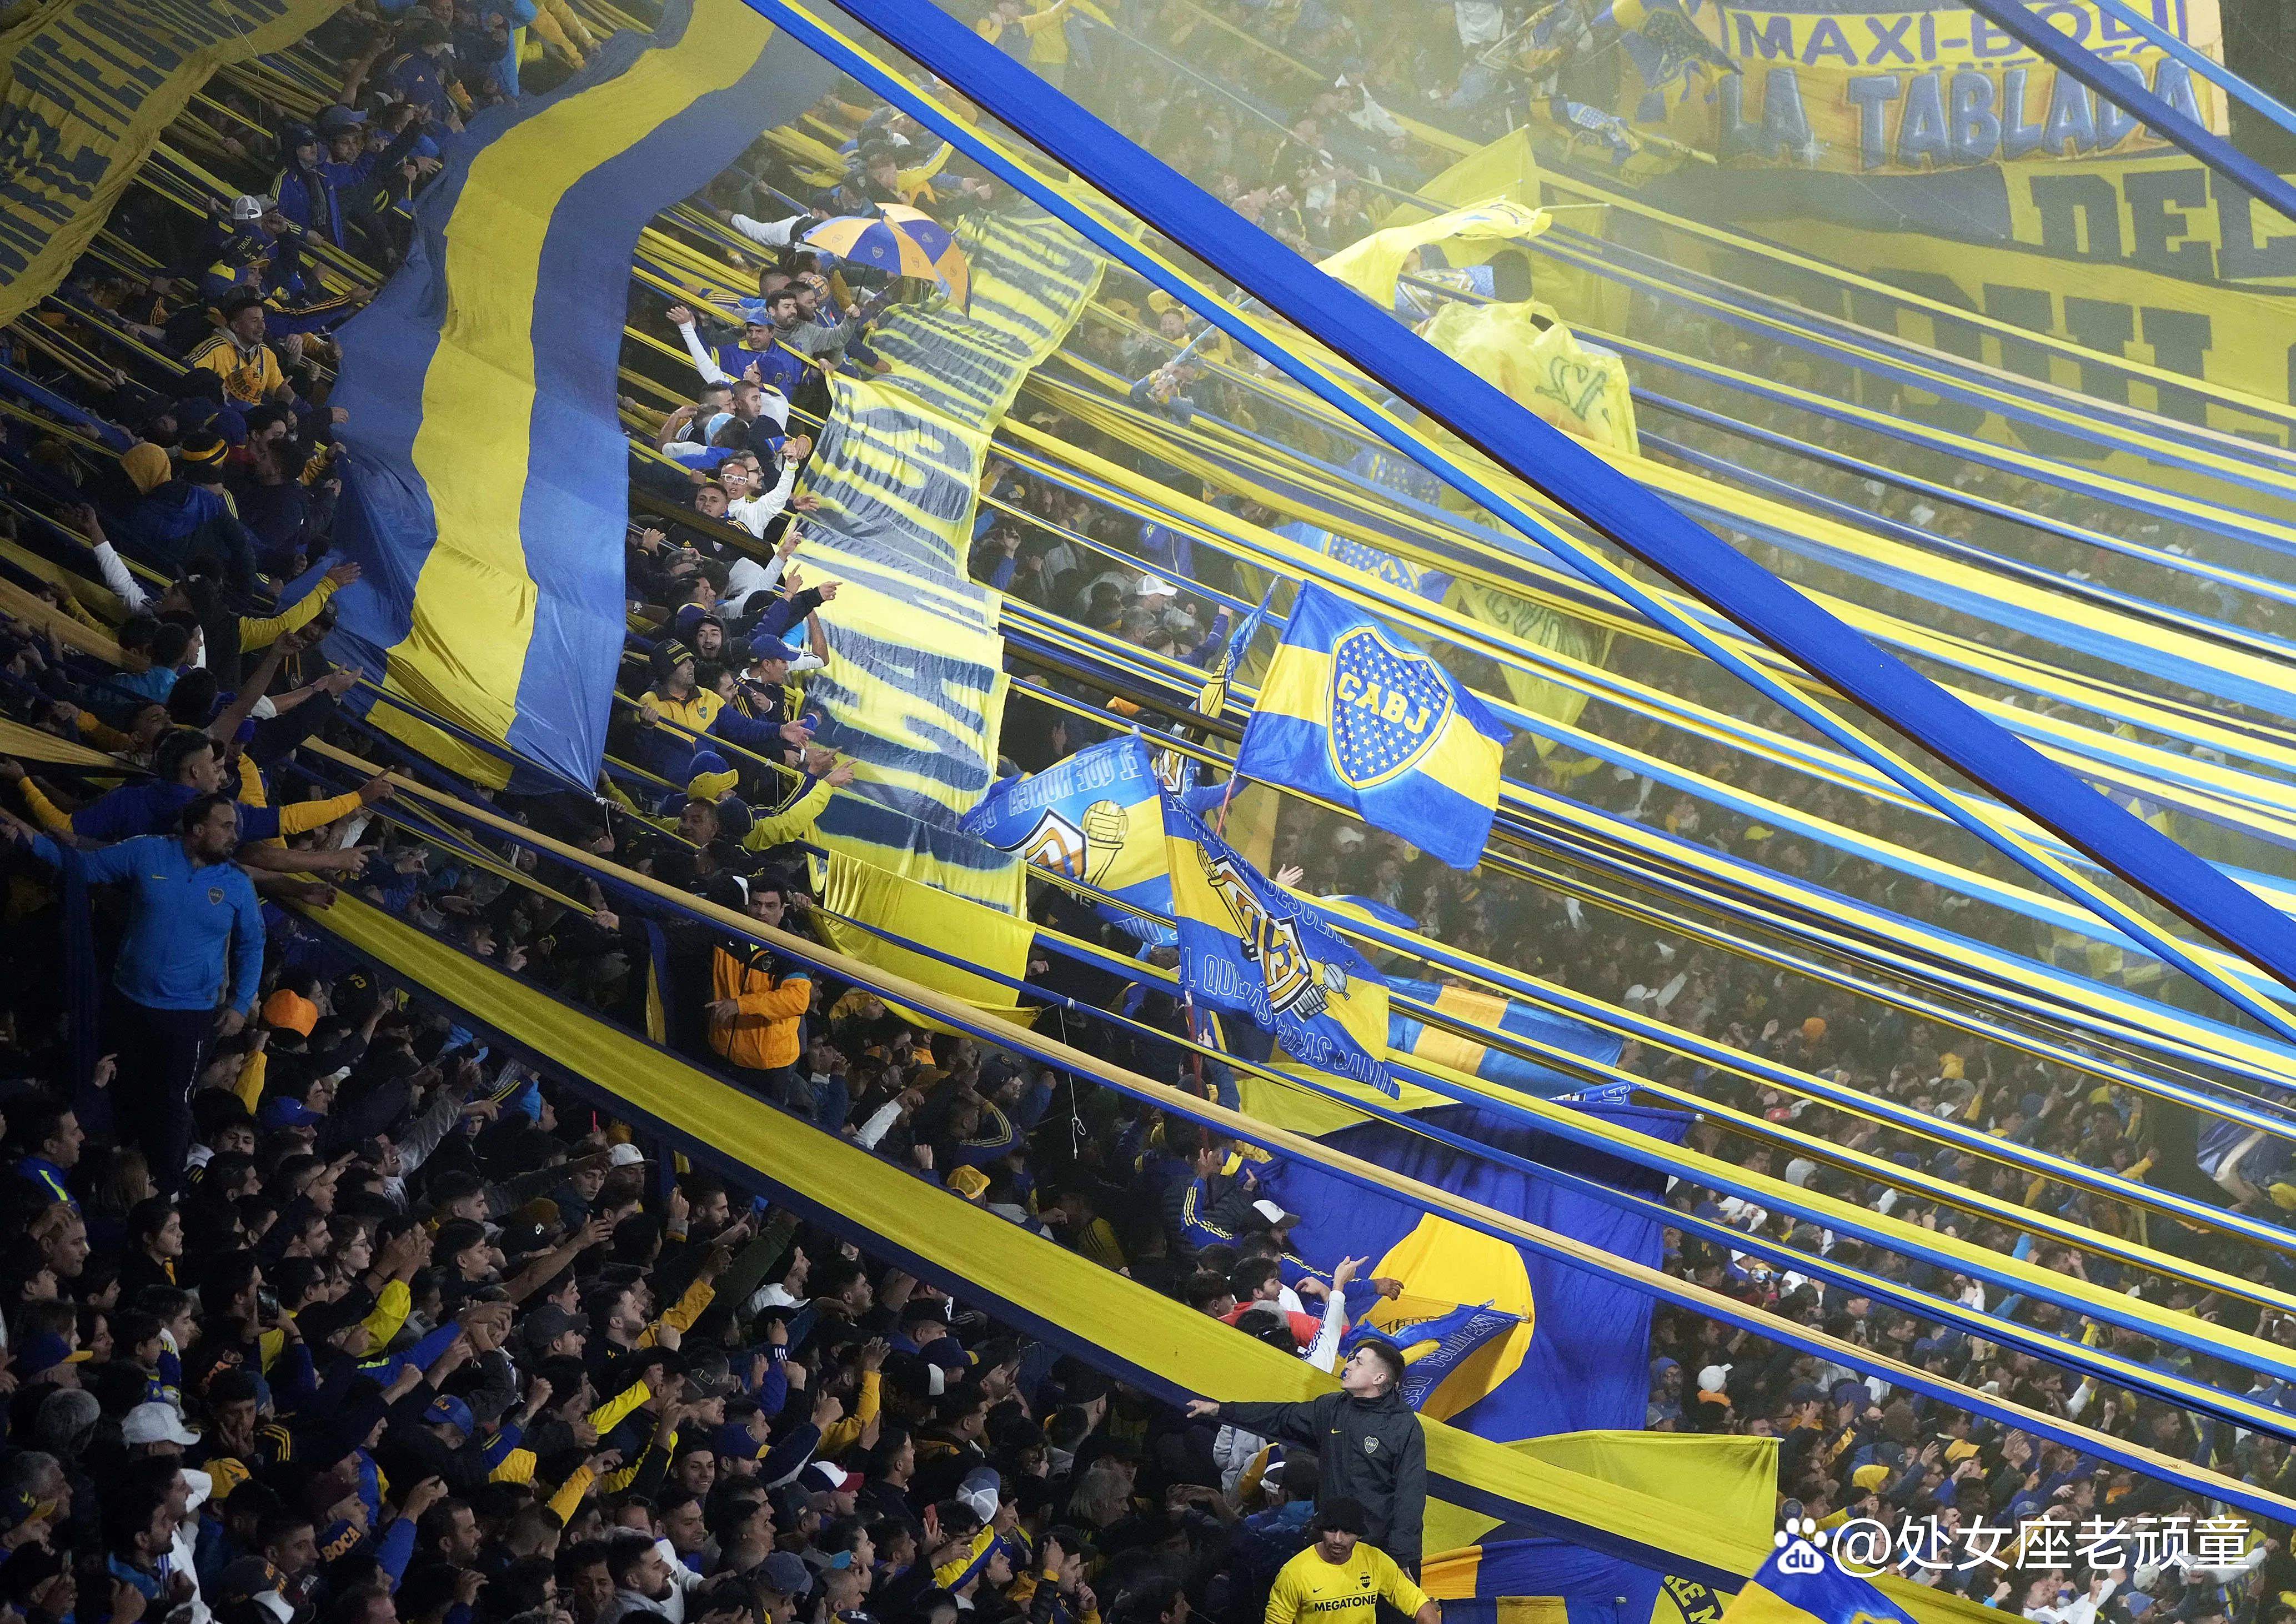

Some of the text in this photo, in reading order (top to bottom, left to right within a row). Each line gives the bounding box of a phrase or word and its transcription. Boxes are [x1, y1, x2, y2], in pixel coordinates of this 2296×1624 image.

[1847, 59, 2205, 169] TABLADA
[1337, 672, 1431, 734] CABJ
[320, 1526, 362, 1562] BOCA
[850, 1611, 868, 1621] 12
[1315, 1594, 1376, 1612] MEGATONE
